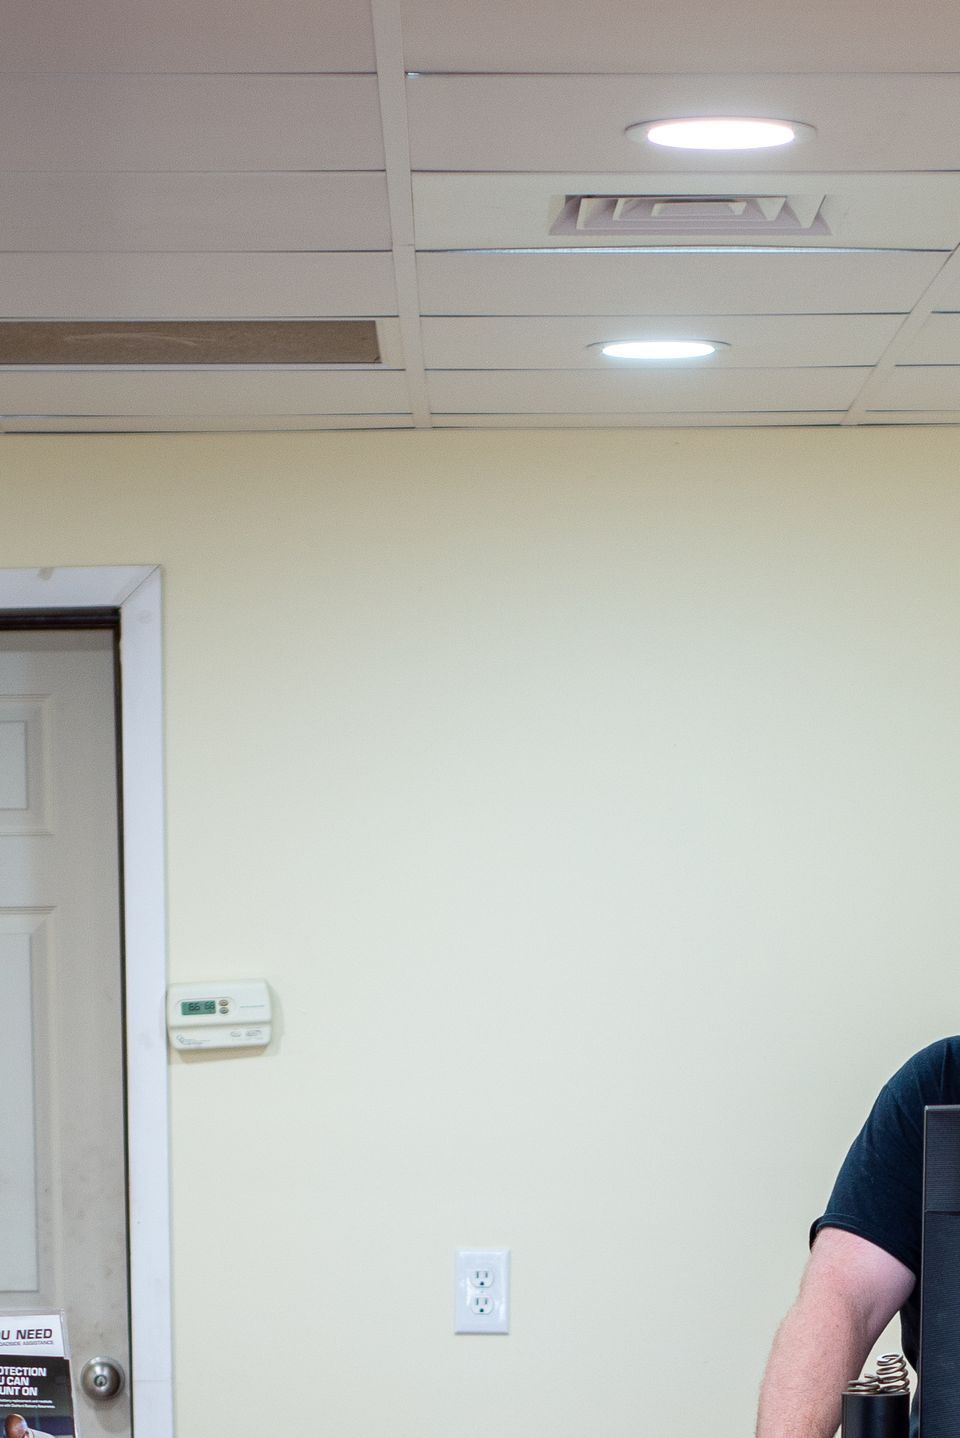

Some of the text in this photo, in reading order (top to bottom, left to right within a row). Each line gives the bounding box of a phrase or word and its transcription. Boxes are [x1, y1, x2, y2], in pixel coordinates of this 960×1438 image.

[16, 1328, 53, 1340] NEED
[6, 1376, 30, 1386] CAN
[21, 1386, 38, 1397] ON
